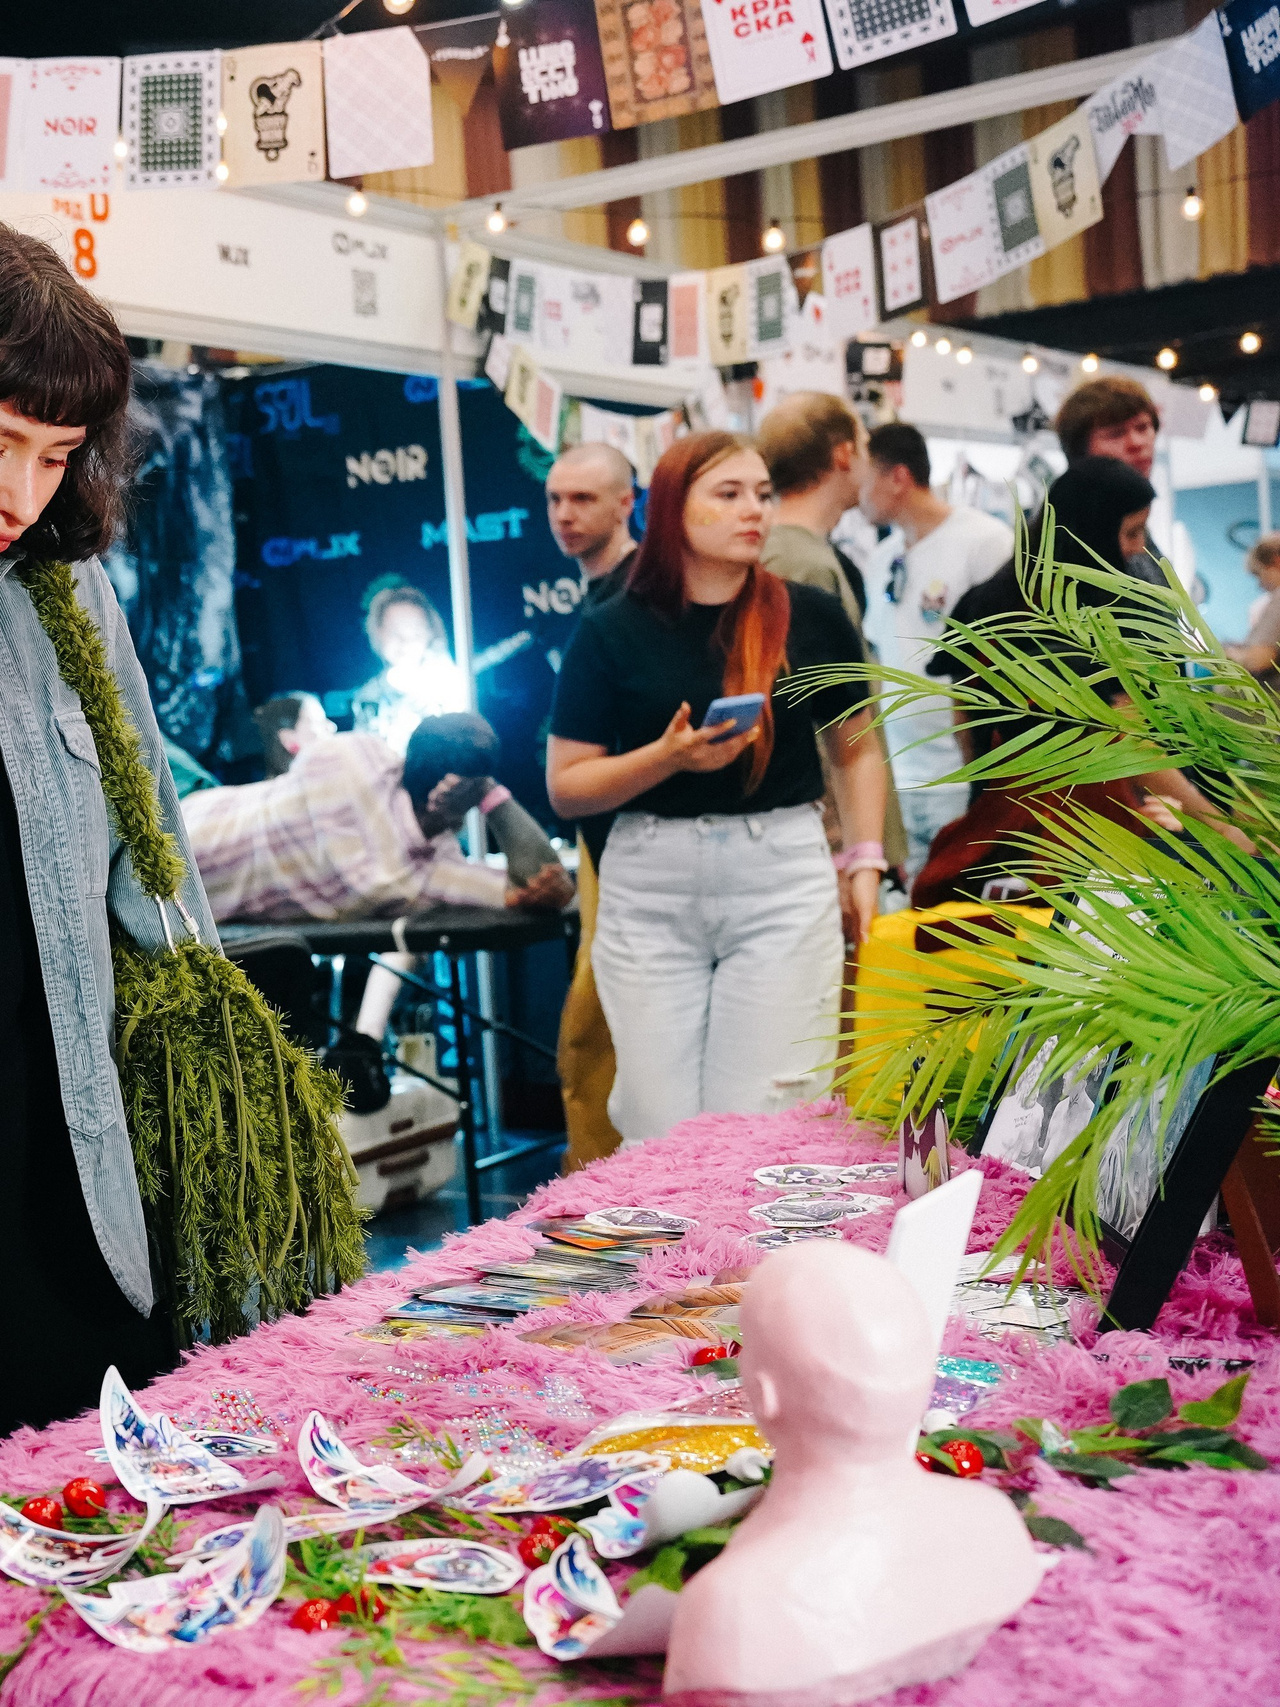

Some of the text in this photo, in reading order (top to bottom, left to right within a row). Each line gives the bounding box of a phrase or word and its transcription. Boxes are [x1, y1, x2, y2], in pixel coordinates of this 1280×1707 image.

[44, 116, 98, 136] NOIR
[74, 228, 98, 279] 8
[345, 444, 429, 489] NOIR
[421, 507, 529, 550] MST
